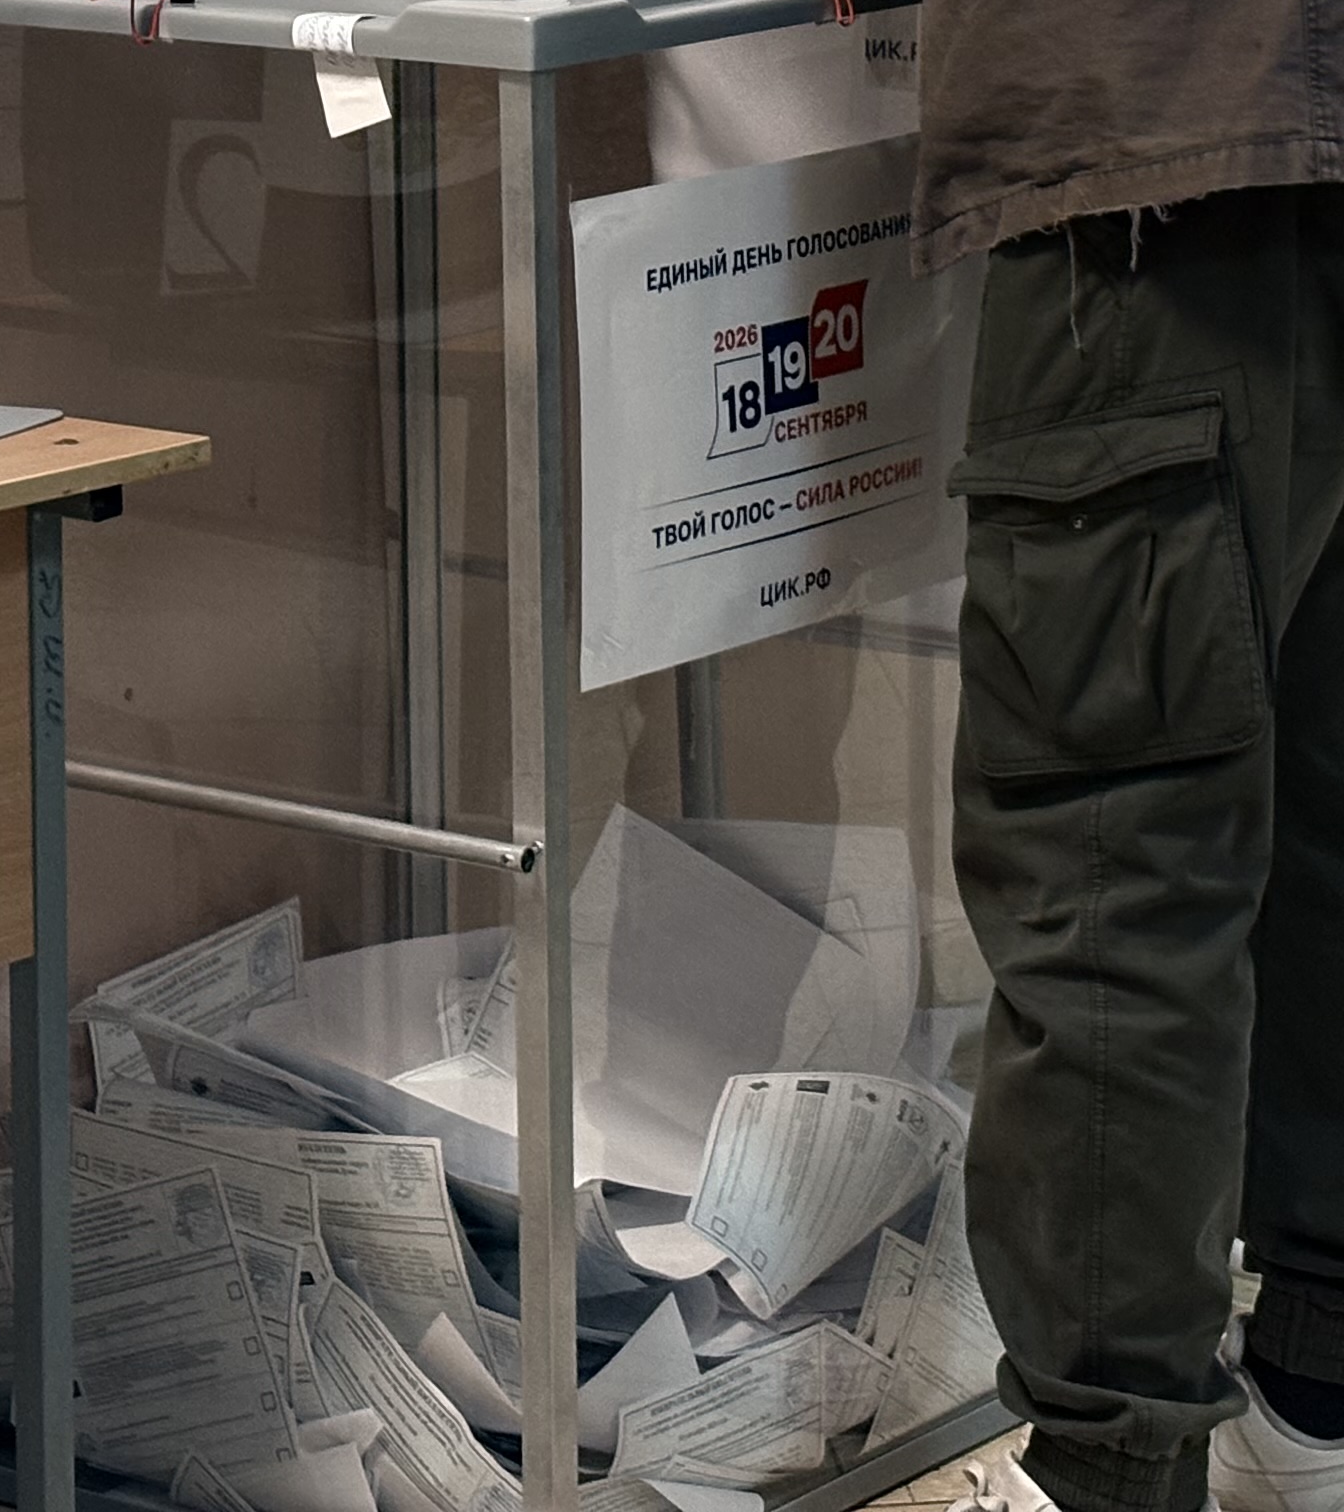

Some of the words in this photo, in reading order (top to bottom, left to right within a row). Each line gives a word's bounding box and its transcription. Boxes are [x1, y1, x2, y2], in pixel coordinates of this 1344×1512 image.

[646, 247, 727, 294] ЕДИНЫЙ
[732, 243, 783, 276] ДЕНЬ
[713, 324, 759, 354] 2026
[813, 303, 860, 360] 20
[767, 340, 807, 395] 19
[721, 380, 762, 434] 18
[774, 400, 868, 443] СЕНТЯБРЯ
[651, 510, 706, 550] ТВОЙ
[710, 498, 775, 535] ГОЛОС
[796, 479, 845, 512] СИЛА
[849, 456, 923, 496] РОССИИ!
[760, 567, 832, 609] ЦИК.РФ
